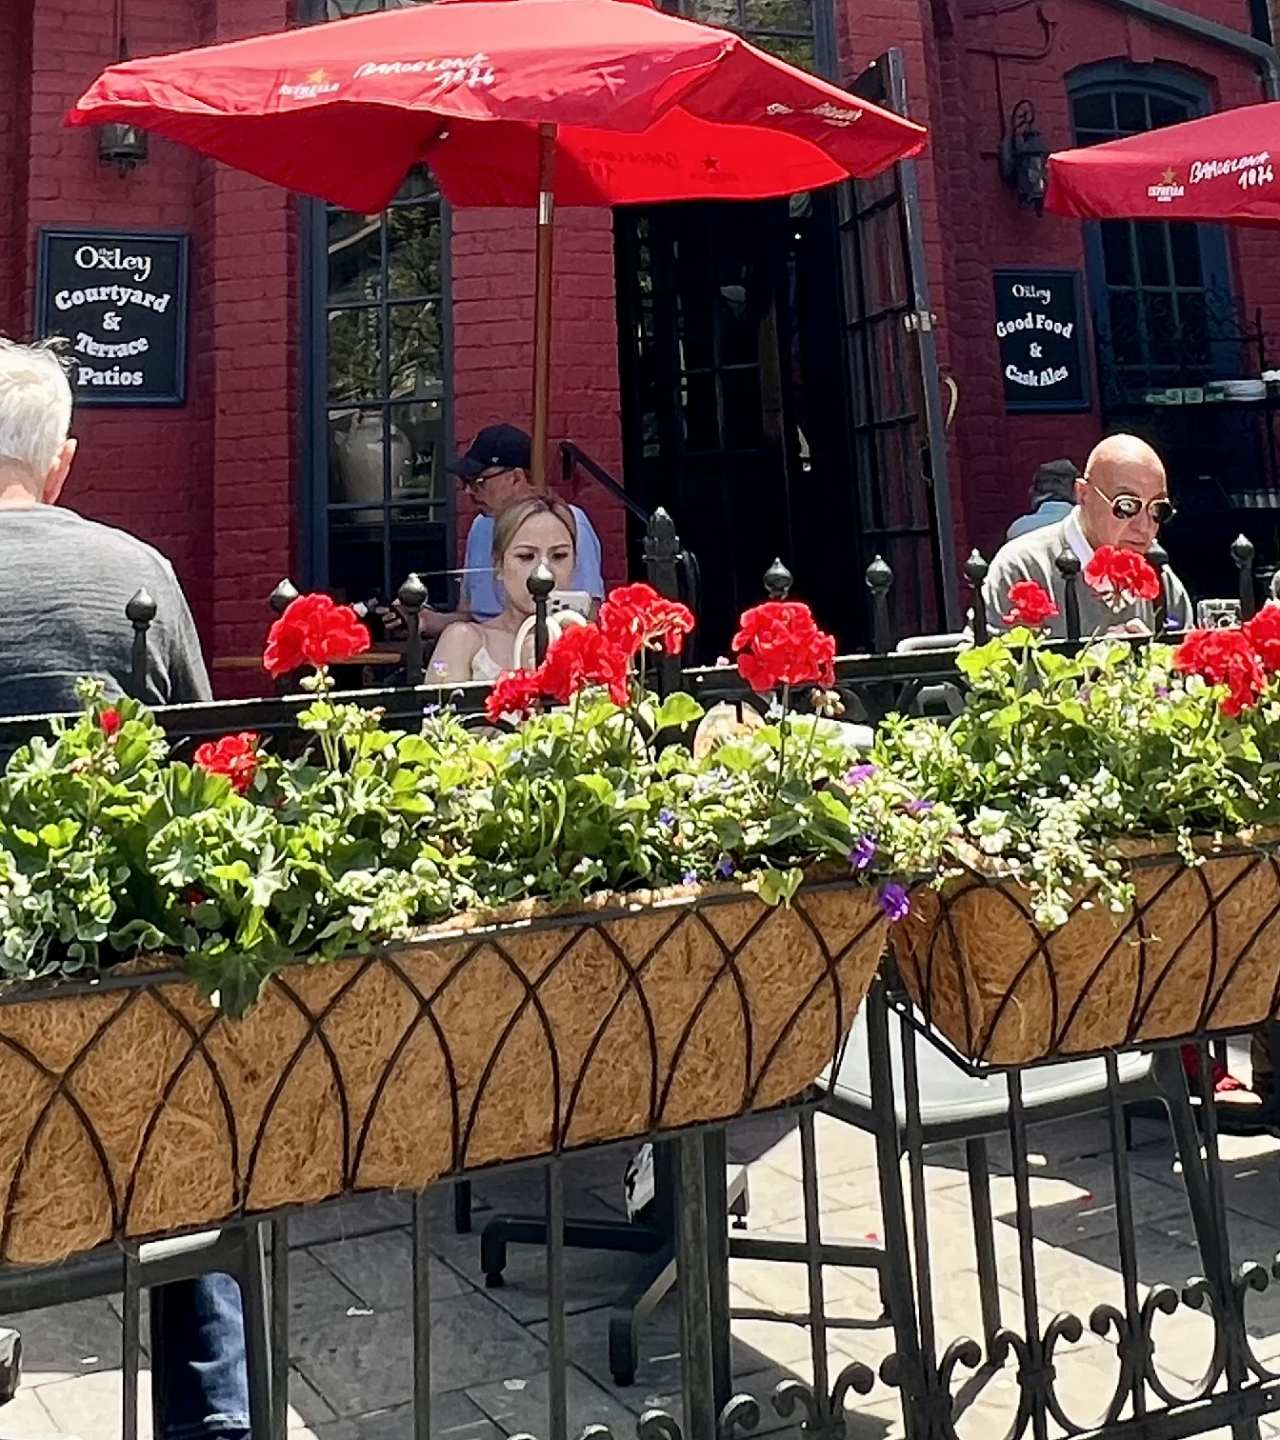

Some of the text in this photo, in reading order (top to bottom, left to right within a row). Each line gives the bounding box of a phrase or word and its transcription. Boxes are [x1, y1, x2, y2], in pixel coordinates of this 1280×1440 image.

[75, 246, 152, 282] Oxley
[55, 284, 172, 313] Courtyard
[102, 311, 122, 331] &
[996, 311, 1074, 339] Good Food
[74, 332, 149, 358] Terrace
[1029, 342, 1043, 358] &
[77, 365, 143, 386] Patios
[1040, 365, 1068, 387] Ales
